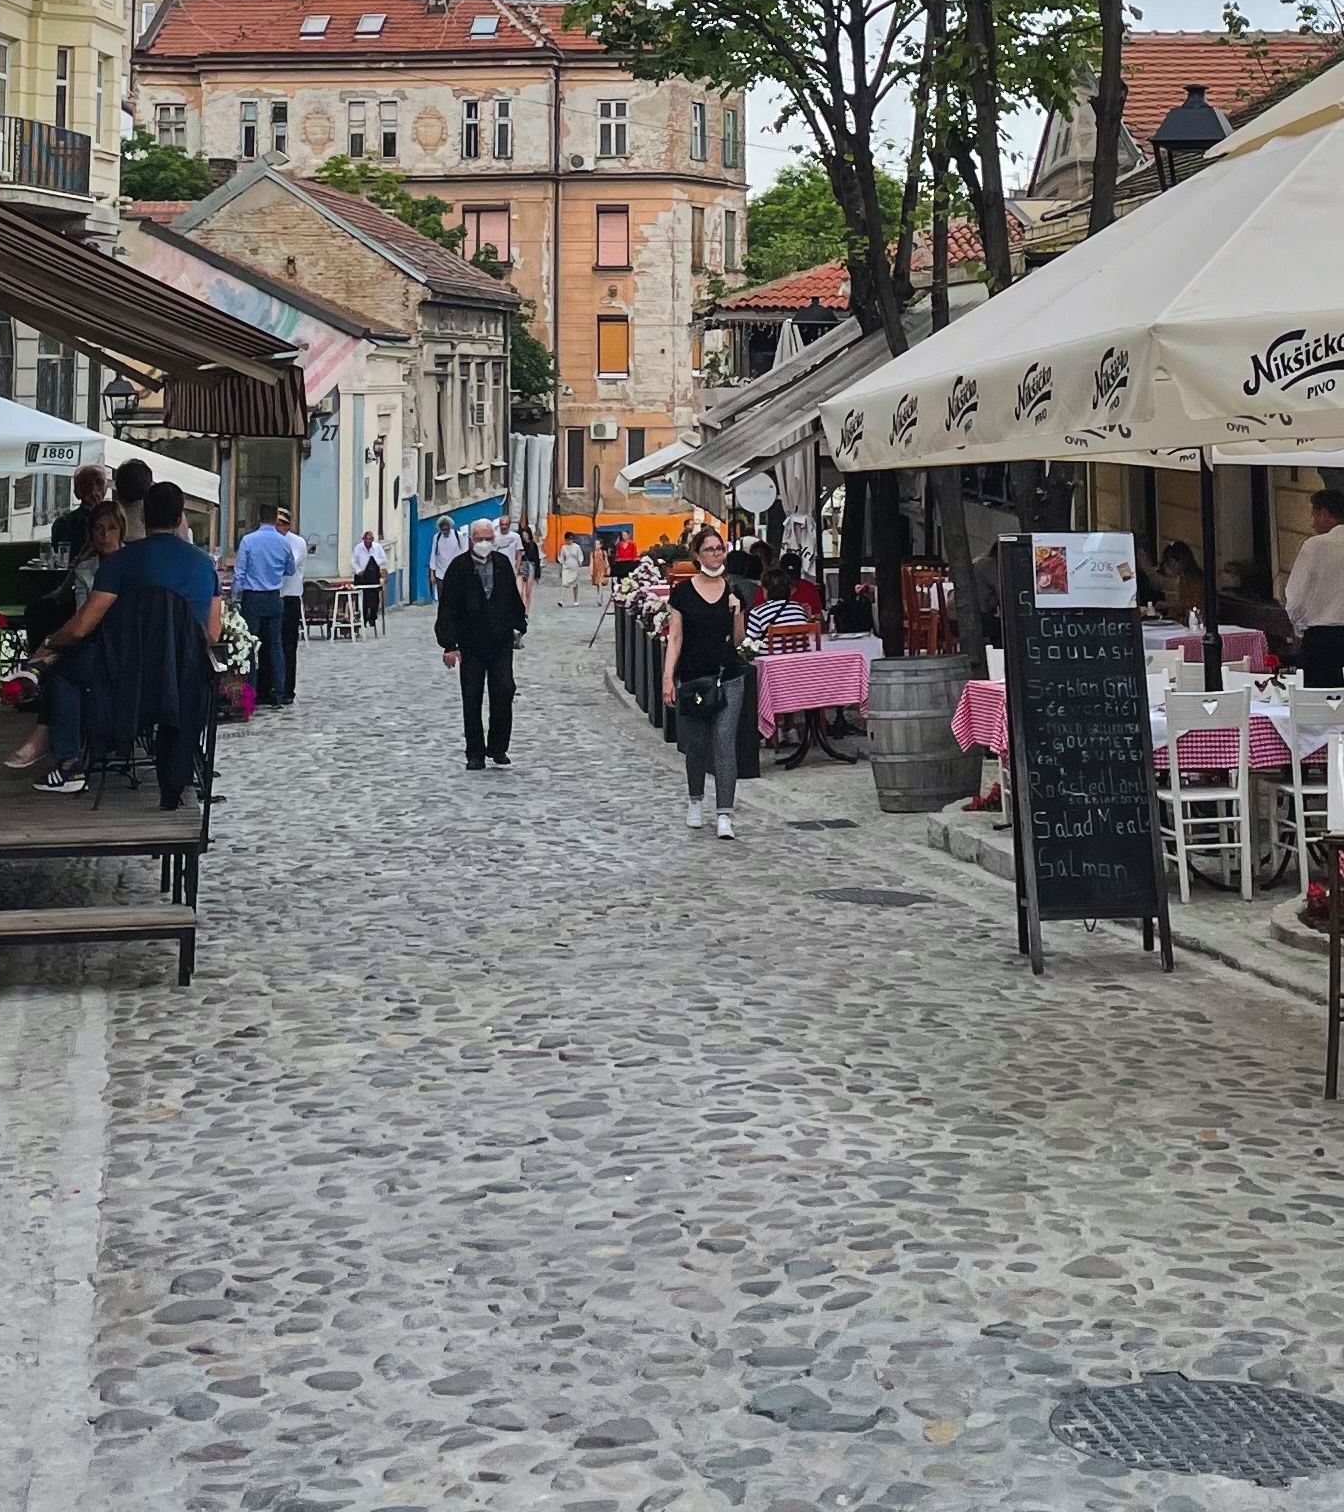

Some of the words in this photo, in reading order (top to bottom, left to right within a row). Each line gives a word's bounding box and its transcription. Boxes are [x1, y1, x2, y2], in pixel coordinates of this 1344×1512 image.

[1306, 378, 1336, 400] PIVO
[321, 424, 339, 441] 27
[42, 447, 74, 459] 1880
[1090, 561, 1114, 572] 20%
[1026, 637, 1134, 664] GOULASH
[1103, 676, 1139, 699] Grill
[1039, 847, 1128, 879] Salmon
